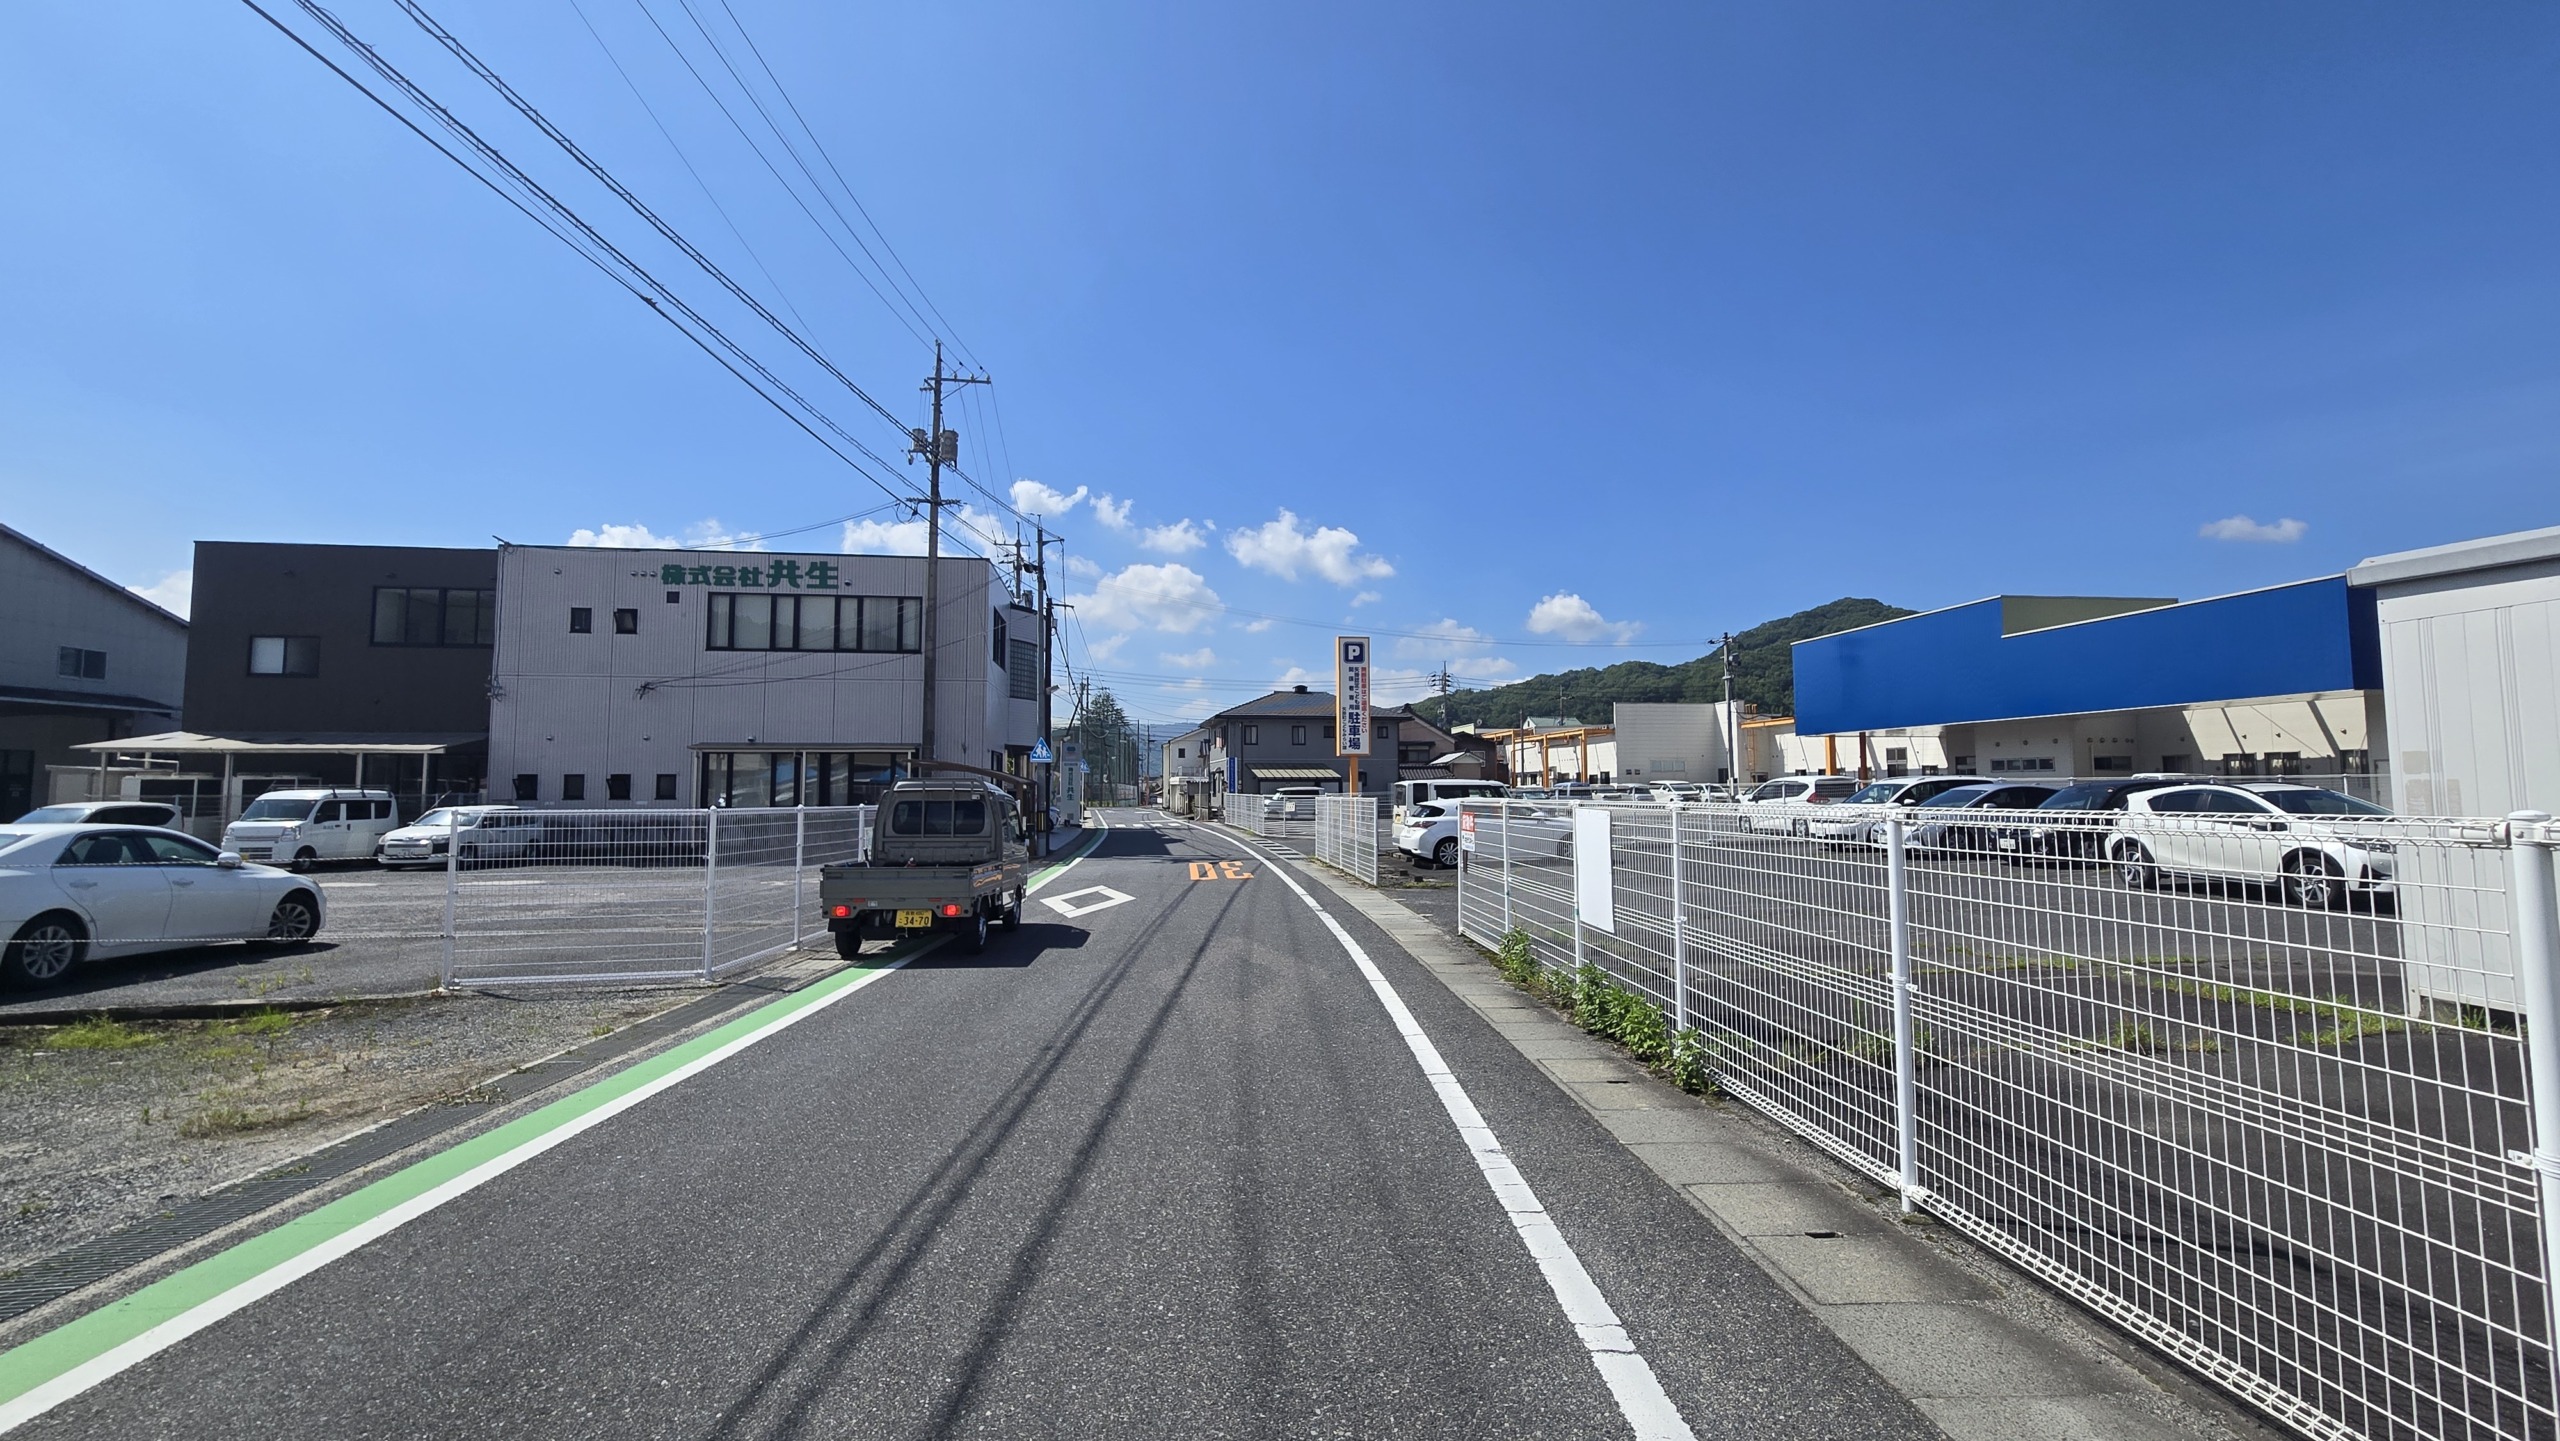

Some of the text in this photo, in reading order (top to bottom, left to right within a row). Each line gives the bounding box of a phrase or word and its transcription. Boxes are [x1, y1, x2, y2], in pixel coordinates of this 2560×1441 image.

[661, 559, 839, 590] 株式会社共生
[1348, 645, 1360, 660] P
[1348, 711, 1361, 750] 駐車場
[904, 916, 930, 925] 34-70
